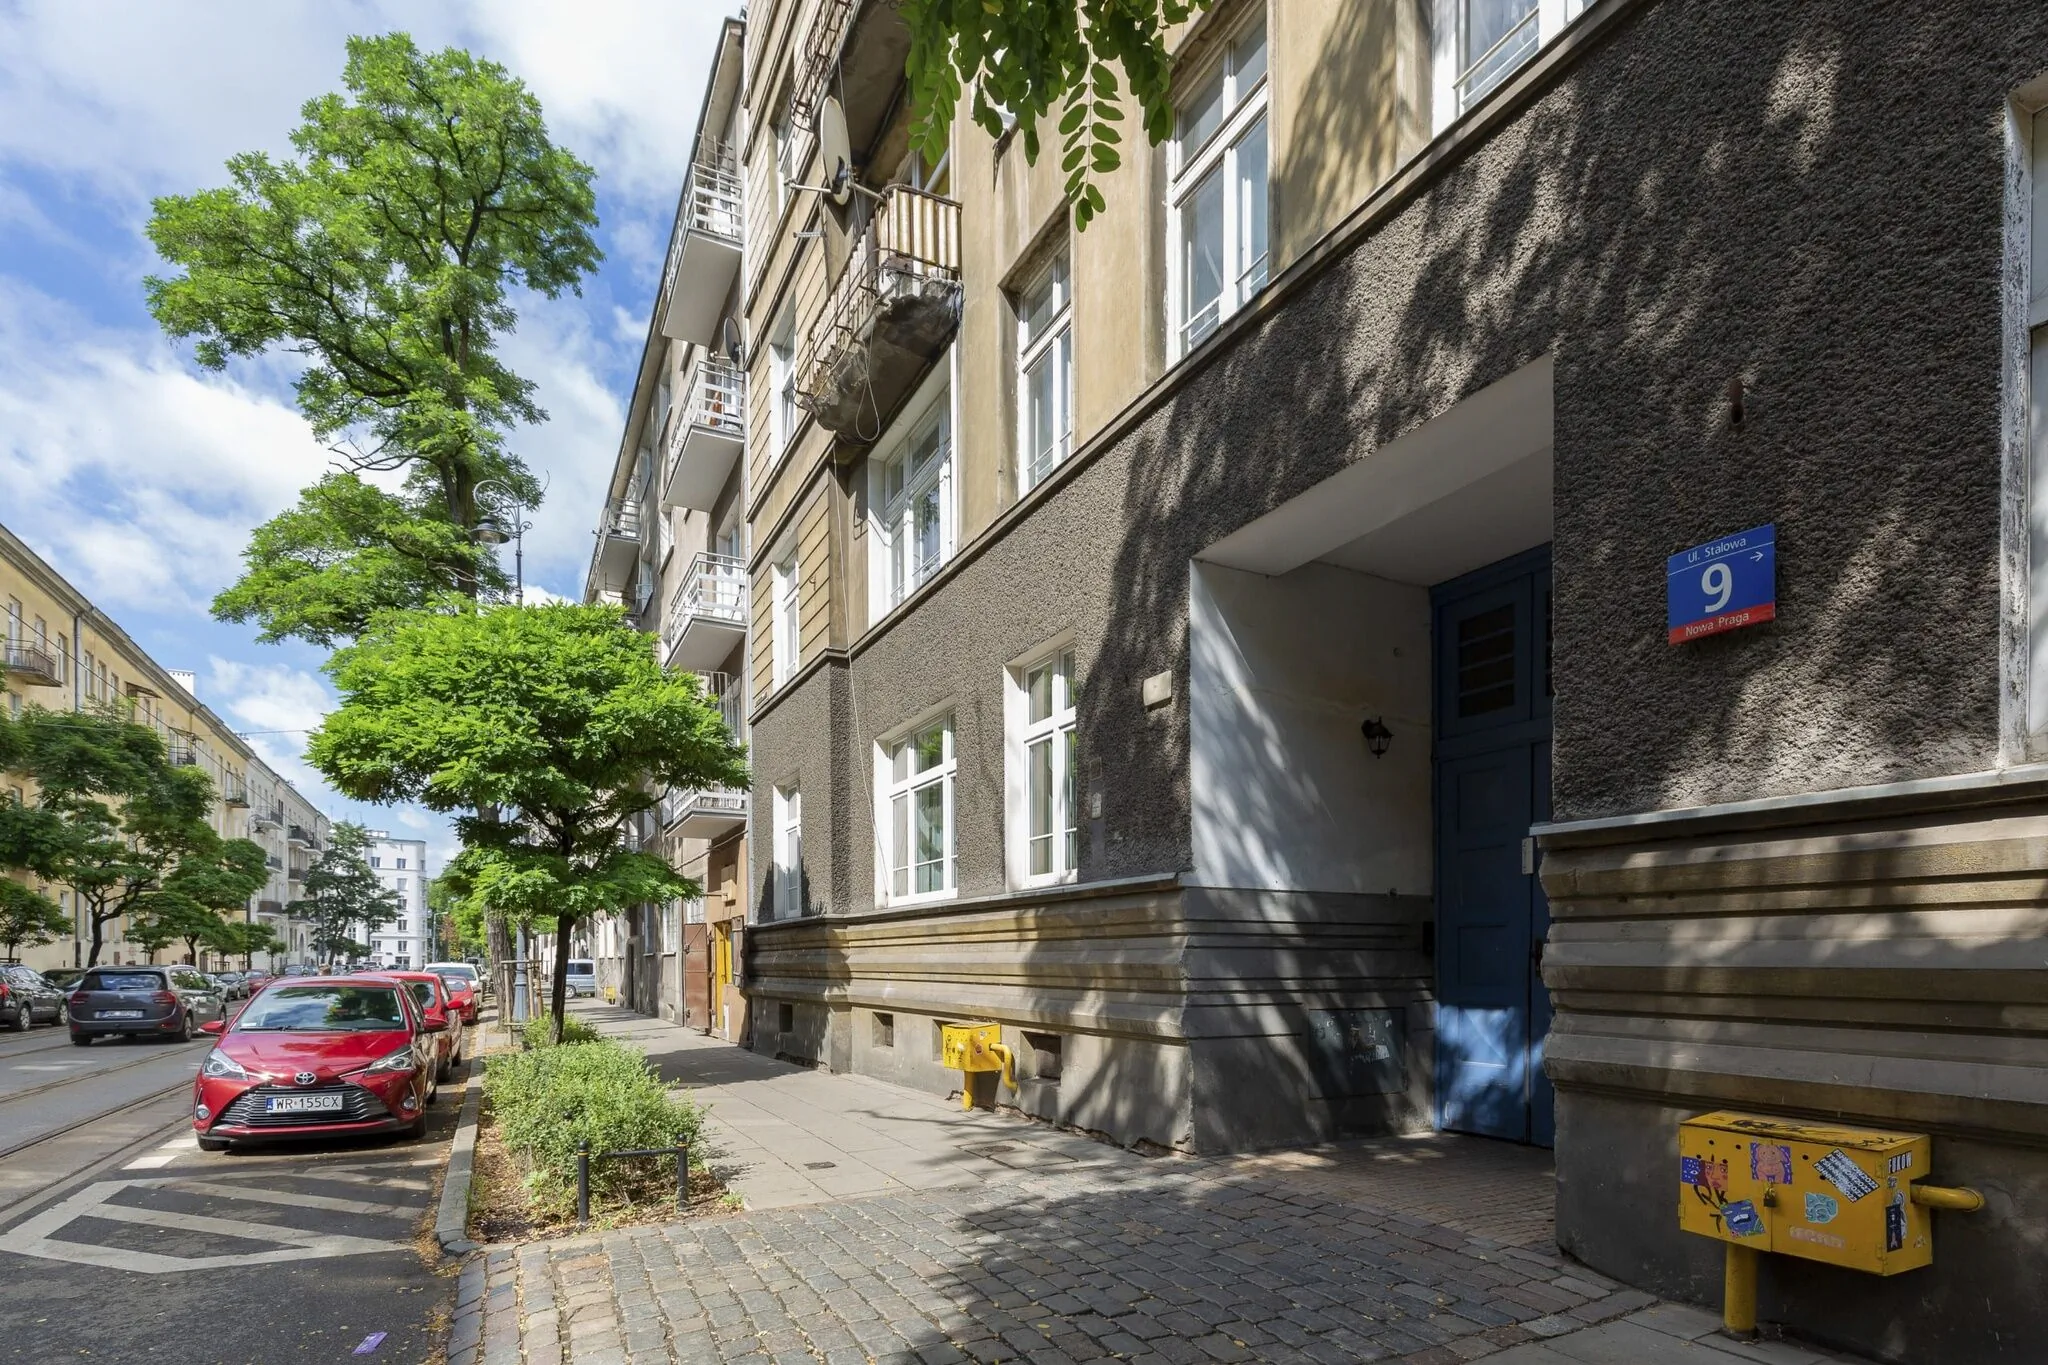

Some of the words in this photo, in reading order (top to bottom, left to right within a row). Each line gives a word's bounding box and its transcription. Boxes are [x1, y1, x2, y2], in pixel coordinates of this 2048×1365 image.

[1688, 551, 1700, 563] Ul.
[1705, 538, 1747, 557] Stalowa
[1701, 563, 1733, 613] 9
[1685, 621, 1714, 637] Nowa
[1718, 612, 1749, 626] Praga
[276, 1098, 293, 1110] WR
[300, 1097, 339, 1109] 155CX
